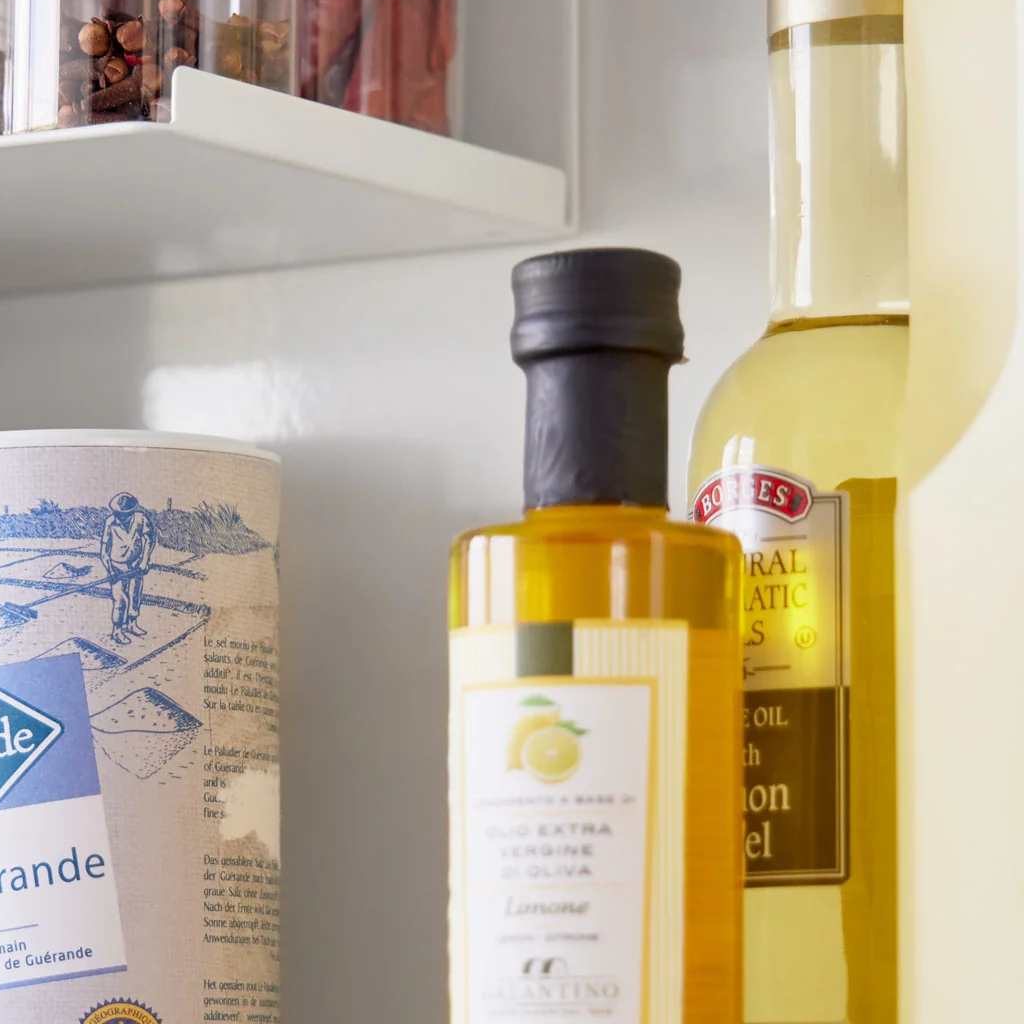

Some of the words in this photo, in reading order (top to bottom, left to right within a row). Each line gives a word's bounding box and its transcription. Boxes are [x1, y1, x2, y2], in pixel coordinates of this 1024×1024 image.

[700, 478, 789, 517] BORGES
[743, 582, 808, 613] ATIC
[754, 706, 788, 726] OIL
[743, 782, 791, 812] on
[4, 957, 21, 971] de
[25, 946, 94, 967] Guérande
